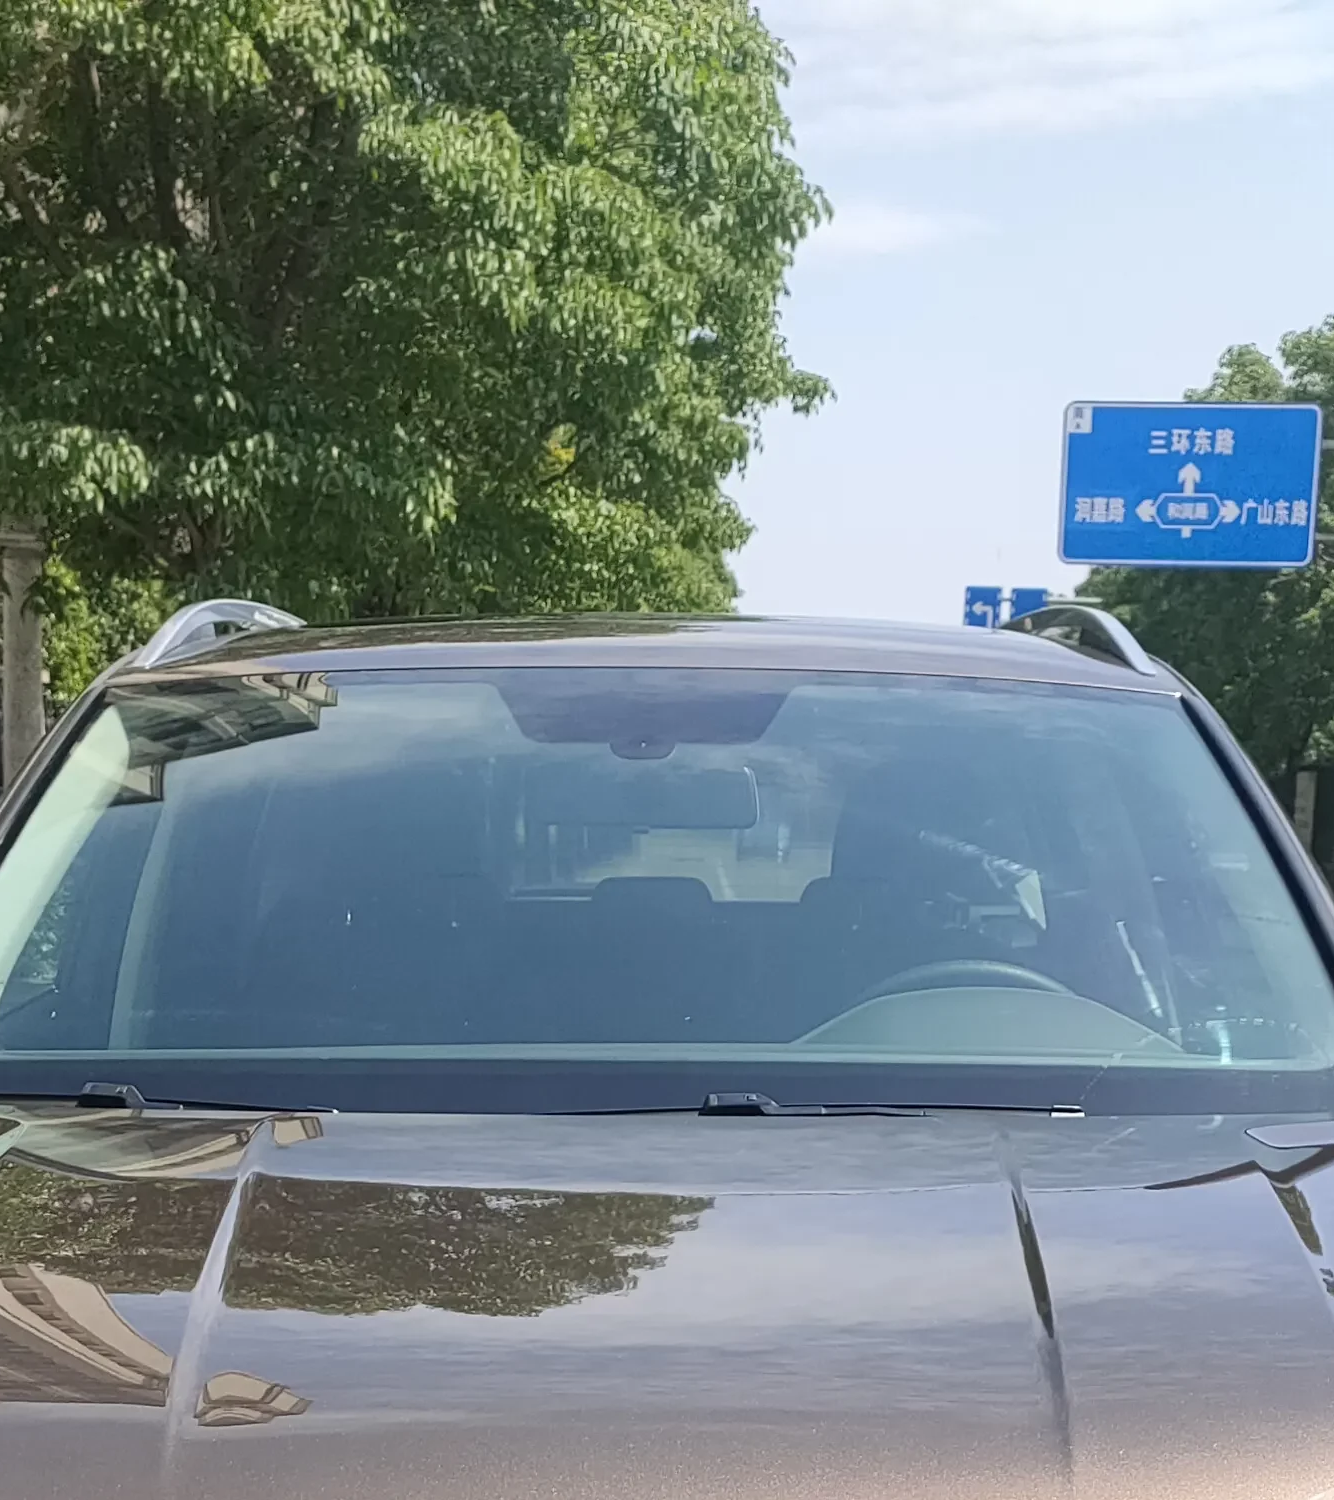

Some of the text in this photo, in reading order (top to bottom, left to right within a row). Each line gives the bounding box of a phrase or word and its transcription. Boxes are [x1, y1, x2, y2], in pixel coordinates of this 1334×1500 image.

[1148, 428, 1235, 455] 三环东路
[1240, 498, 1308, 526] 广山东路
